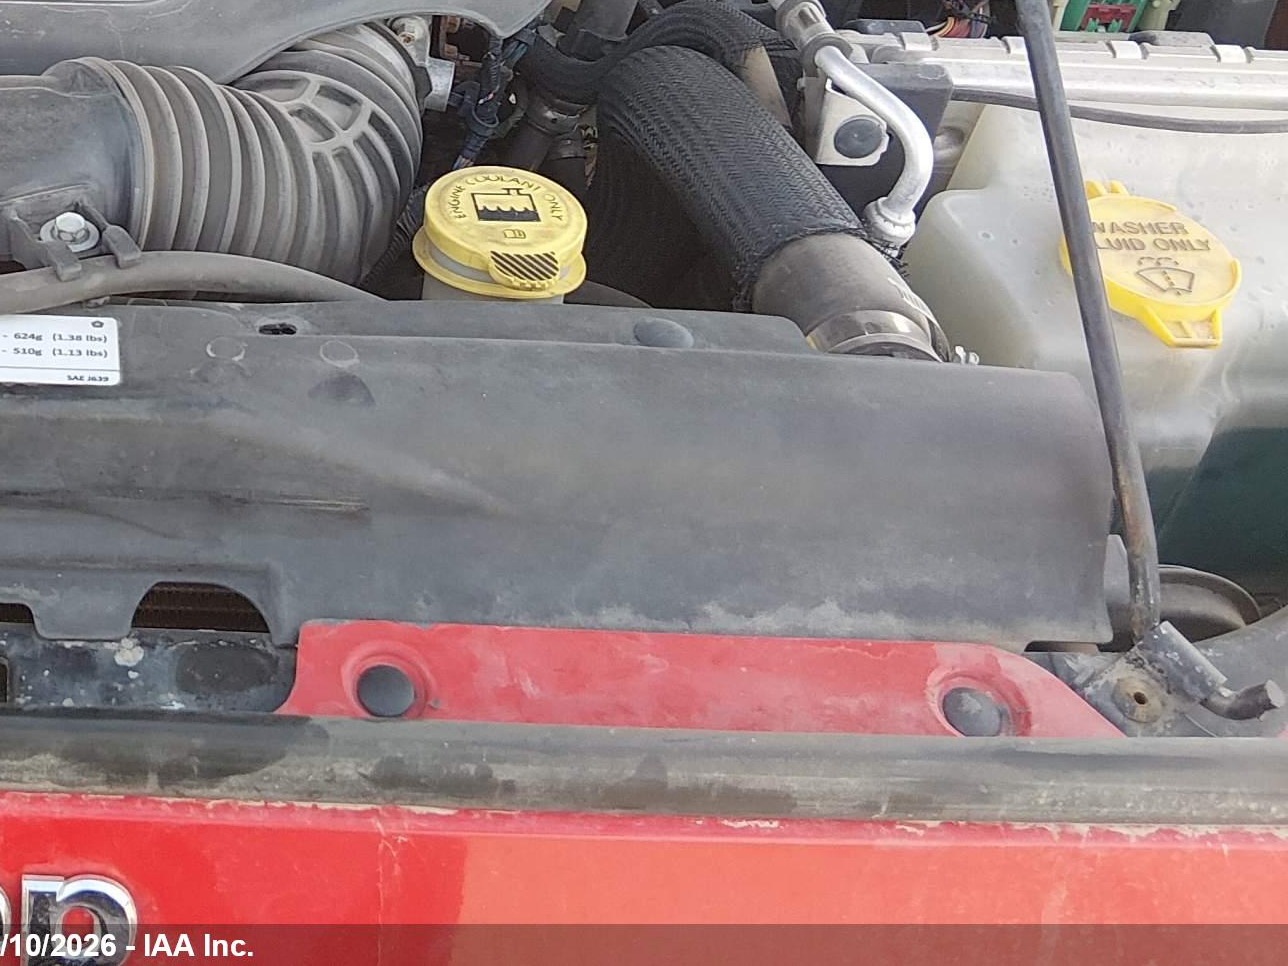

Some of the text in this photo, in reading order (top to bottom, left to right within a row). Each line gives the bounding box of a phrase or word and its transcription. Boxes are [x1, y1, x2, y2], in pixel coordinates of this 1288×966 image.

[448, 174, 564, 222] ENGINE COOLANT ONLY
[1090, 221, 1190, 235] WASHER
[1096, 237, 1211, 251] LUID ONLY
[14, 332, 43, 342] 624g
[86, 334, 108, 344] lbs)
[13, 347, 42, 357] 510g
[52, 347, 83, 358] (1.13
[86, 348, 109, 359] lbs)
[67, 374, 85, 382] SAE
